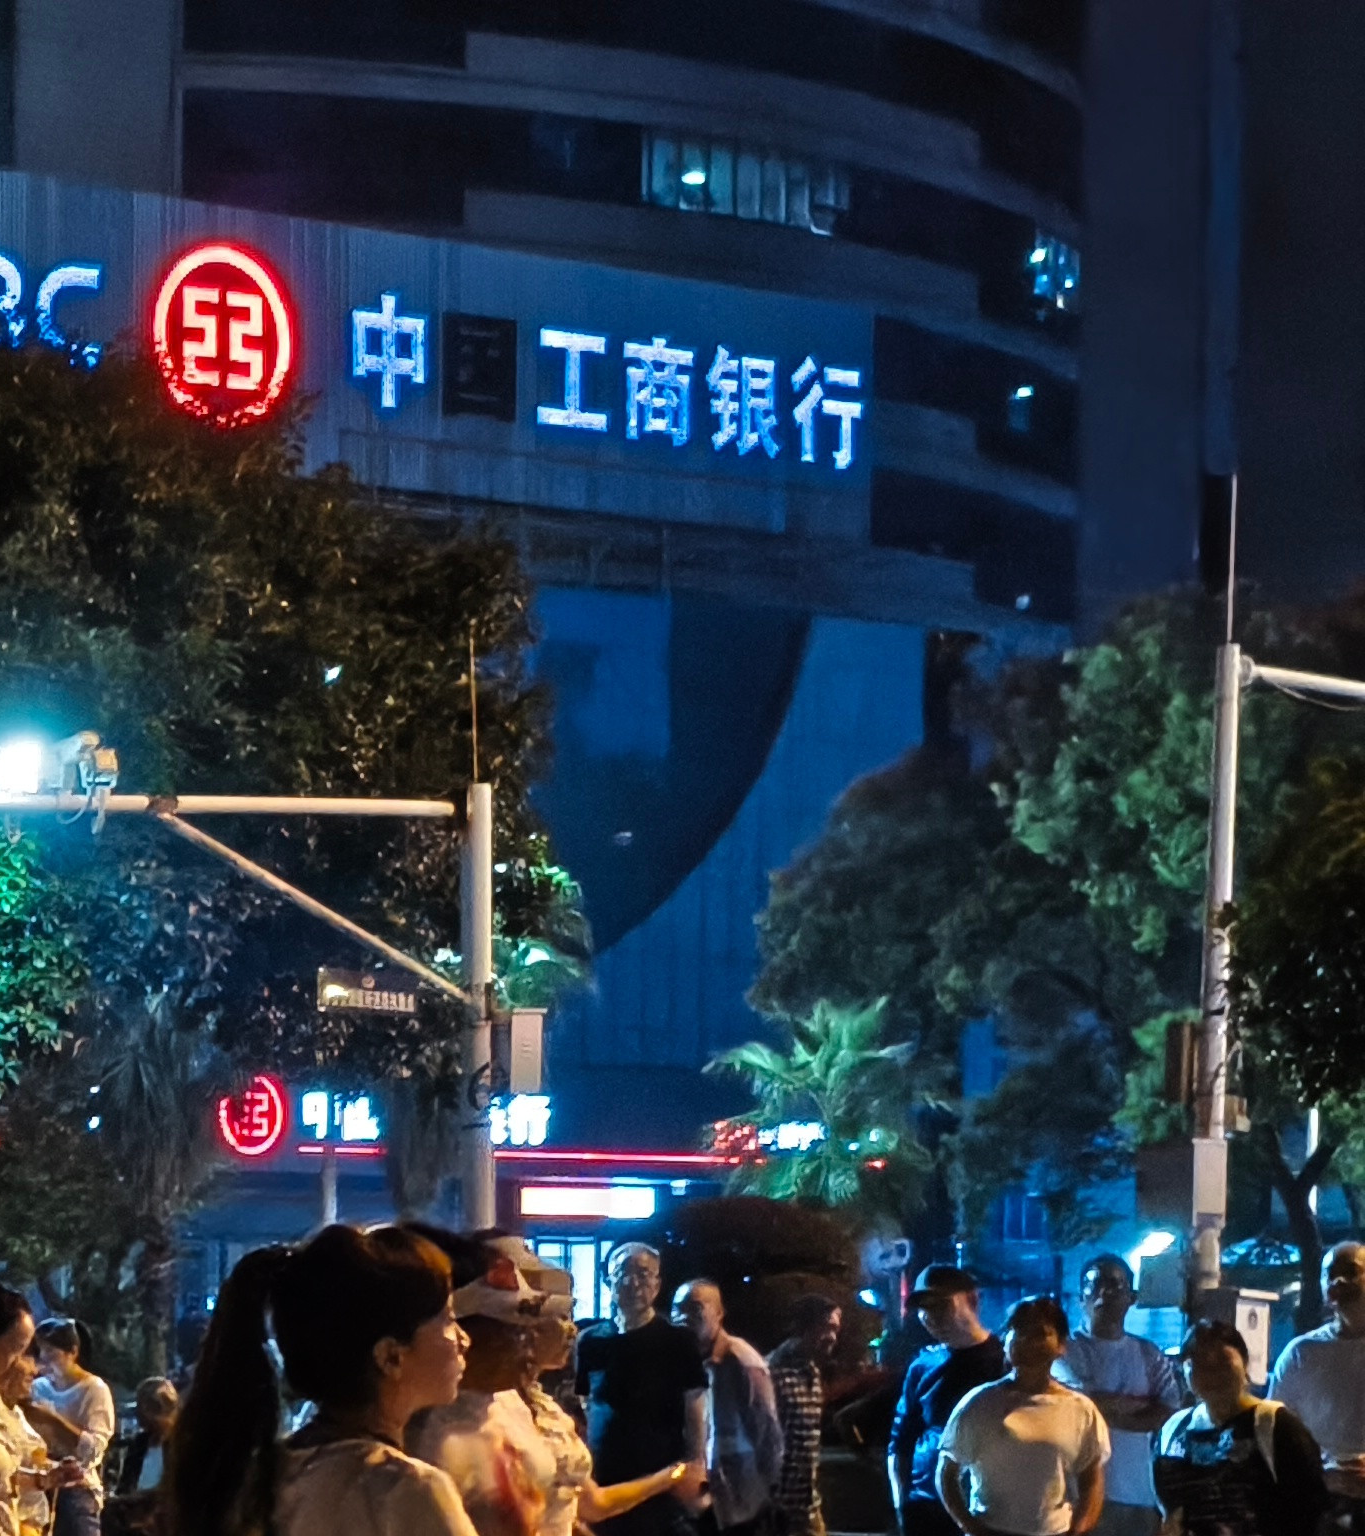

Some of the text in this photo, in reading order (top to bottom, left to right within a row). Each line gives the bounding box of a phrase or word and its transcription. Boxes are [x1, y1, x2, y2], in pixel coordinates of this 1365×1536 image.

[351, 292, 865, 471] 中工商银行
